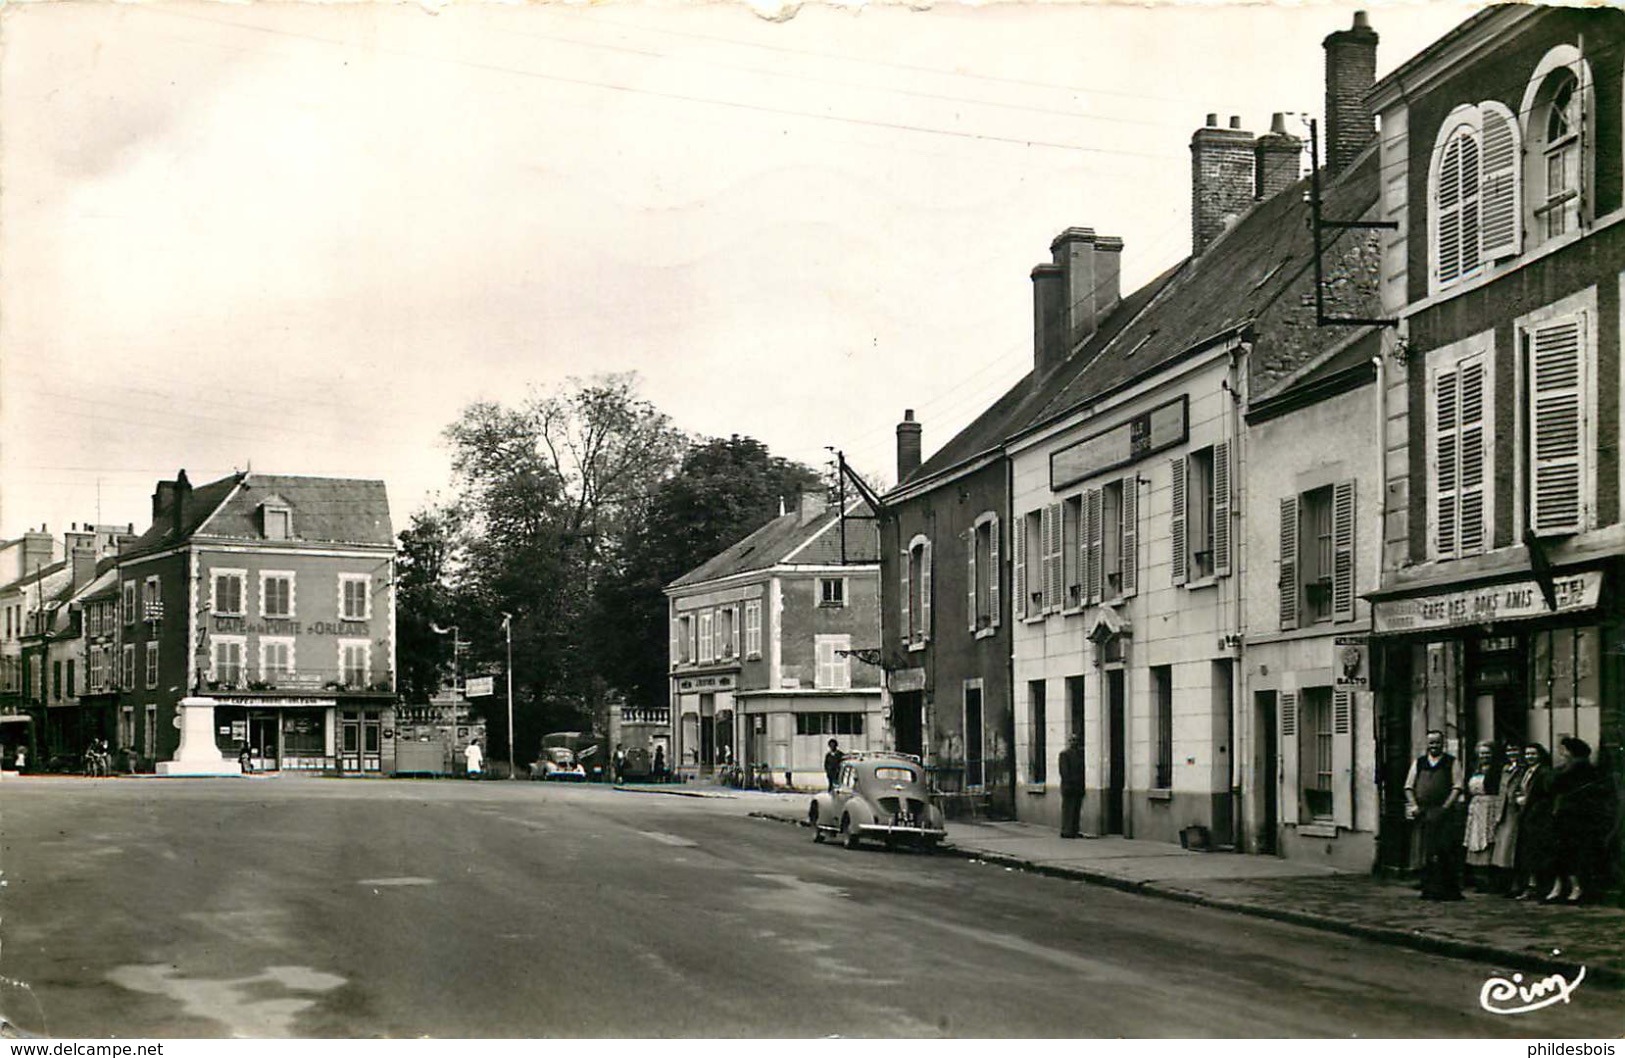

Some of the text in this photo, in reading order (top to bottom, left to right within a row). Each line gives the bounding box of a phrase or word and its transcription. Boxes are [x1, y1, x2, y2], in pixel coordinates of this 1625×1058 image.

[1448, 599, 1467, 616] DES
[1474, 593, 1499, 613] BONS
[1505, 589, 1534, 609] AMIS
[1336, 677, 1367, 685] BALTO
